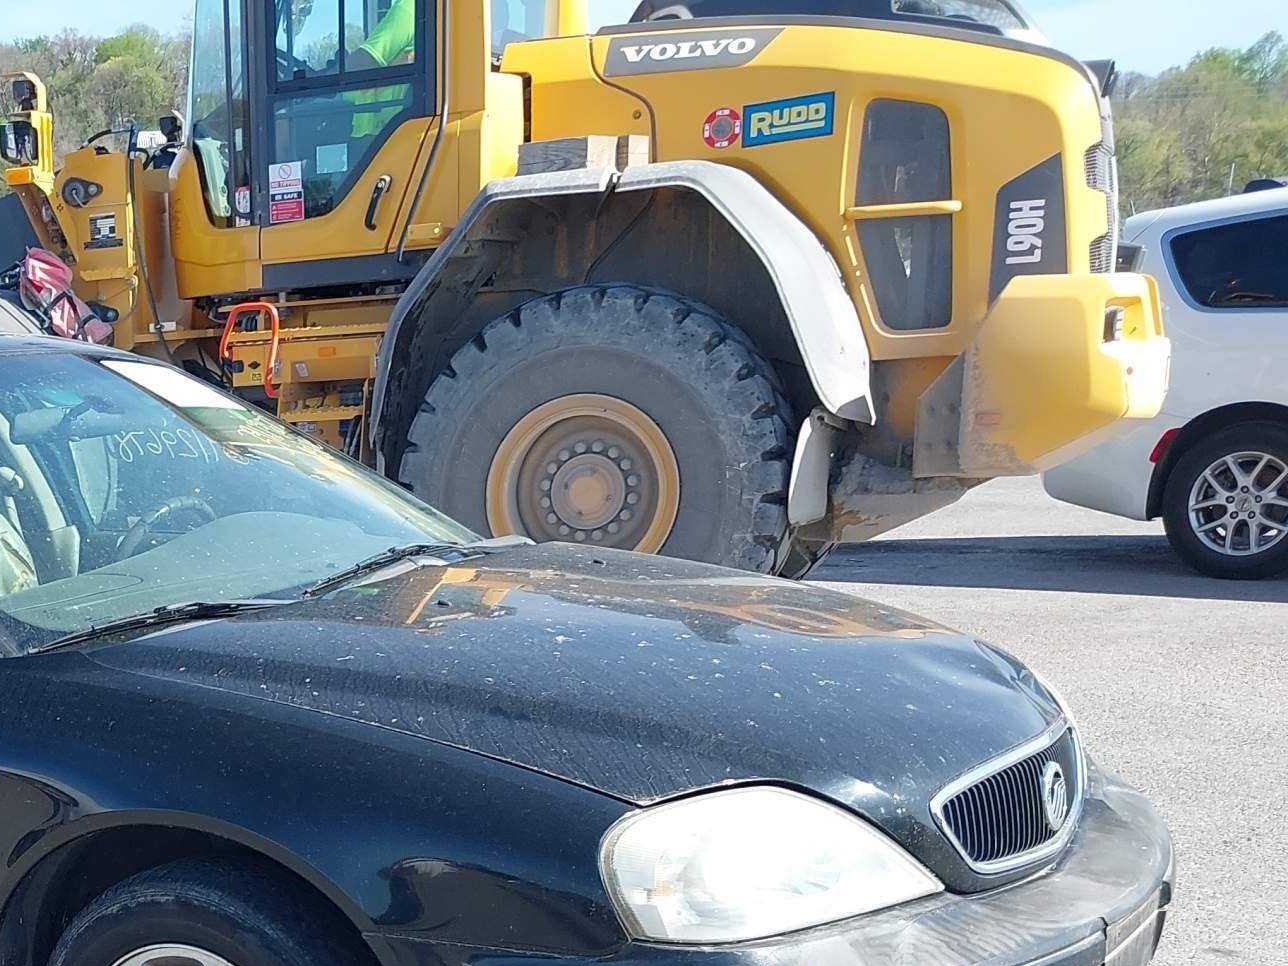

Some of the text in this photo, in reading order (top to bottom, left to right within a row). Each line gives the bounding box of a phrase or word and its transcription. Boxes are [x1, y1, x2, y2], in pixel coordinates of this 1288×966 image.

[620, 37, 756, 63] VOLVO
[750, 102, 826, 138] RUDD
[1005, 199, 1046, 264] L90H
